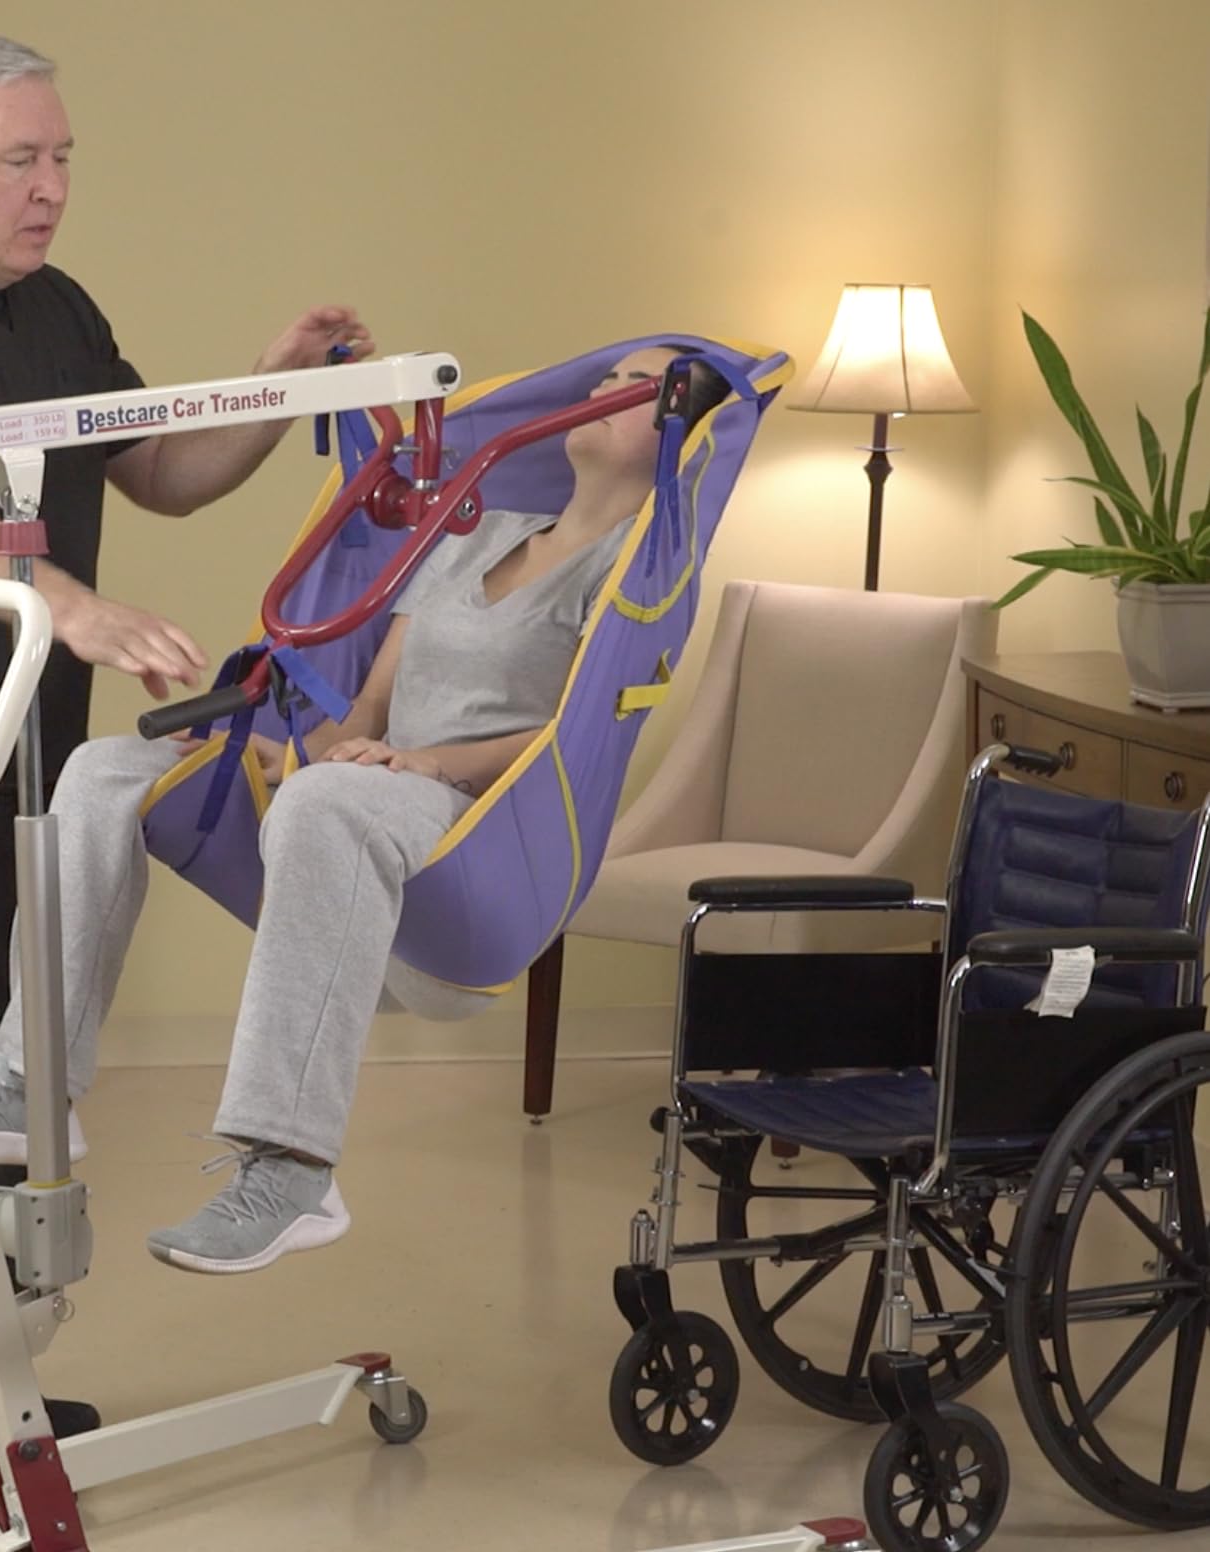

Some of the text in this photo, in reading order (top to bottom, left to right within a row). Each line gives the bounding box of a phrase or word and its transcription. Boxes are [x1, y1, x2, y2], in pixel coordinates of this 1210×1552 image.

[77, 387, 287, 435] Bestcare Car Transfer
